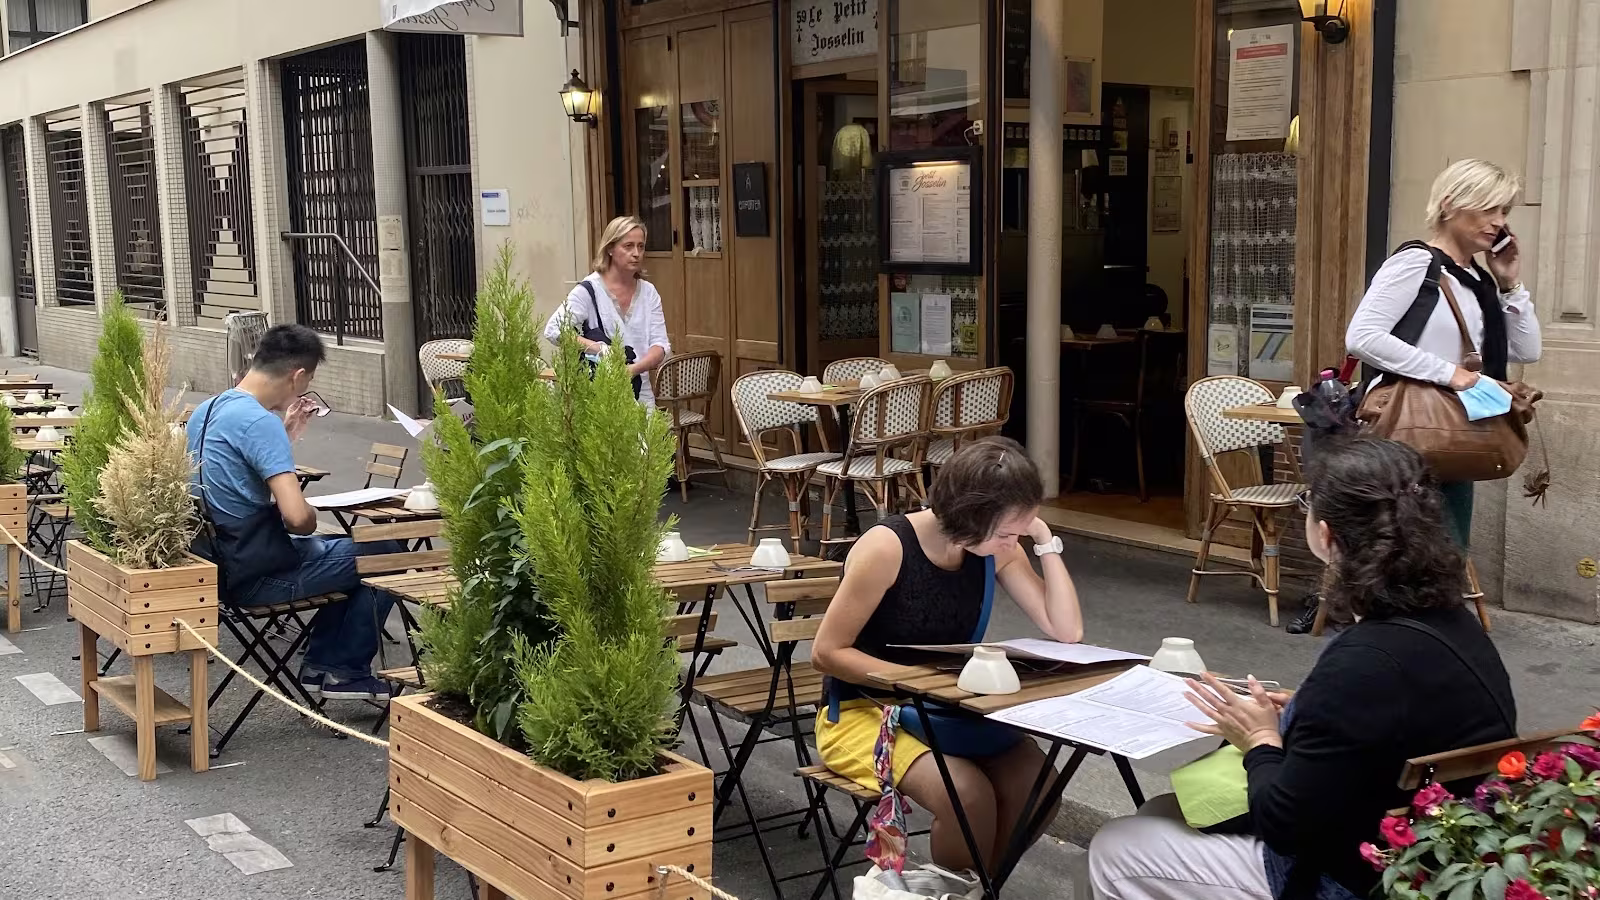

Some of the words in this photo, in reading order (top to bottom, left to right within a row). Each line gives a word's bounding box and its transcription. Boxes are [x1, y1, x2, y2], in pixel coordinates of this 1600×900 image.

[796, 10, 807, 23] 59
[834, 0, 867, 24] Petit
[811, 27, 864, 56] Josselin
